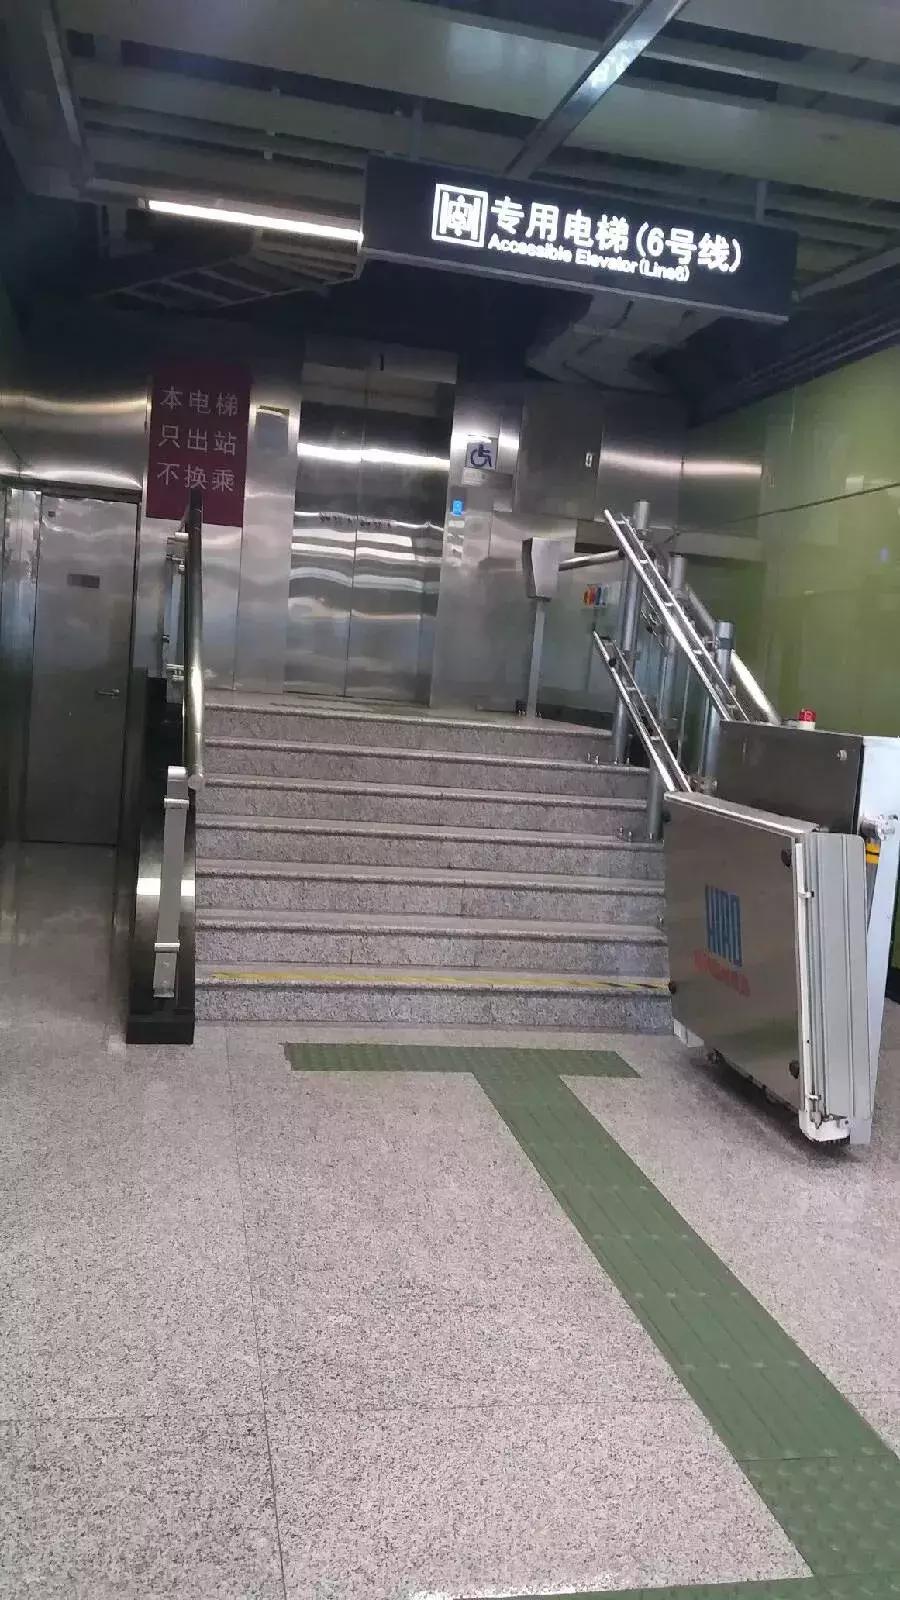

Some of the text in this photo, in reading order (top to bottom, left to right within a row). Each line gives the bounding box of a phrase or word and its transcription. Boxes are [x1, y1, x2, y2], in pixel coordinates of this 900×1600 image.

[487, 232, 573, 263] Accessible
[159, 385, 239, 417] 本电梯
[158, 424, 238, 457] 只出站
[156, 462, 235, 493] 不换乘
